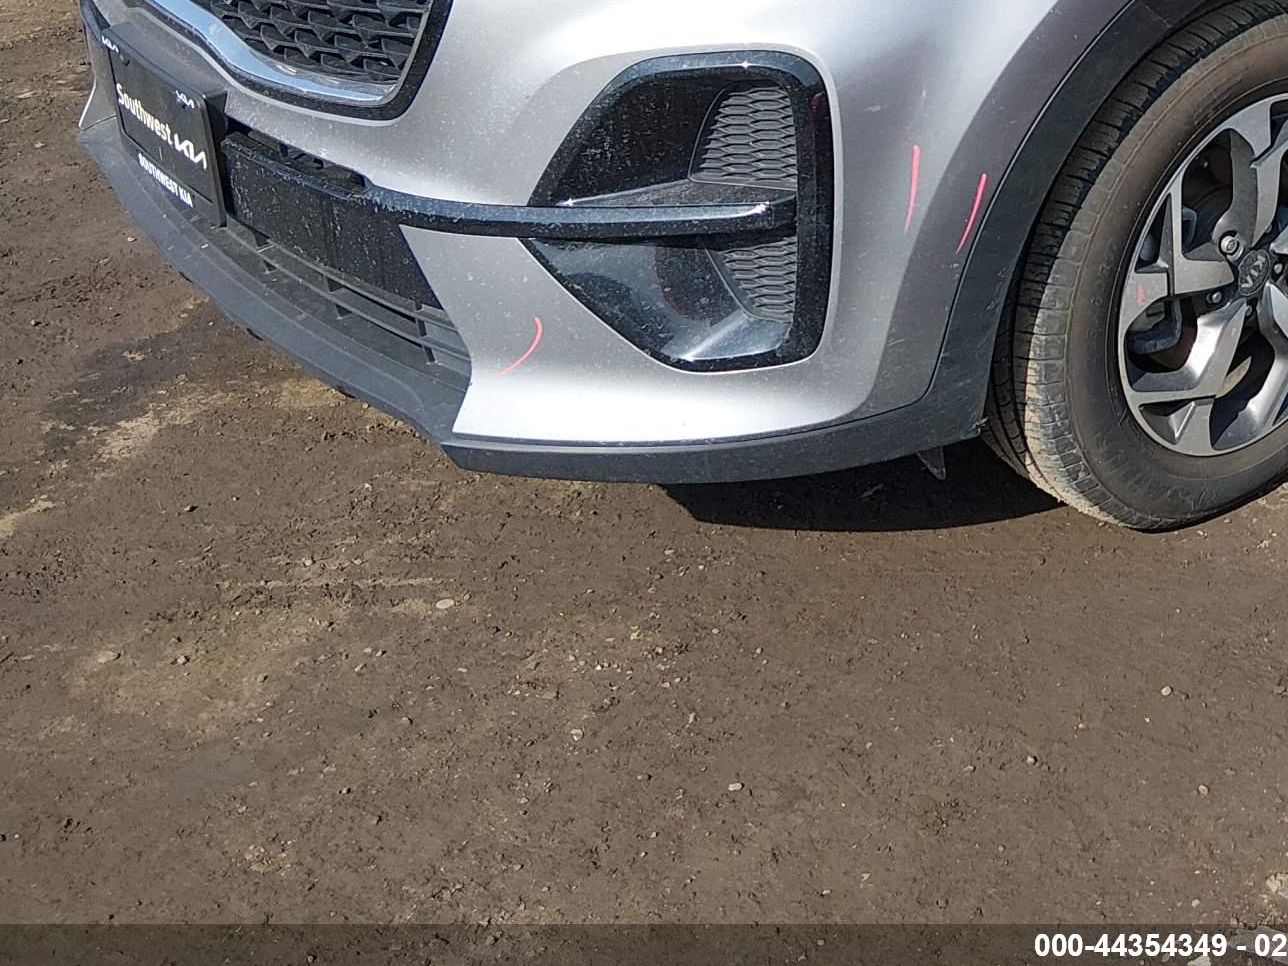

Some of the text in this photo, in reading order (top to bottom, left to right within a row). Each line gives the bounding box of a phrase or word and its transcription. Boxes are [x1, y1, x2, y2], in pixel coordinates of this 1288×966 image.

[115, 82, 208, 171] Southwest KIA
[136, 151, 195, 208] SOUTHWEST KIA
